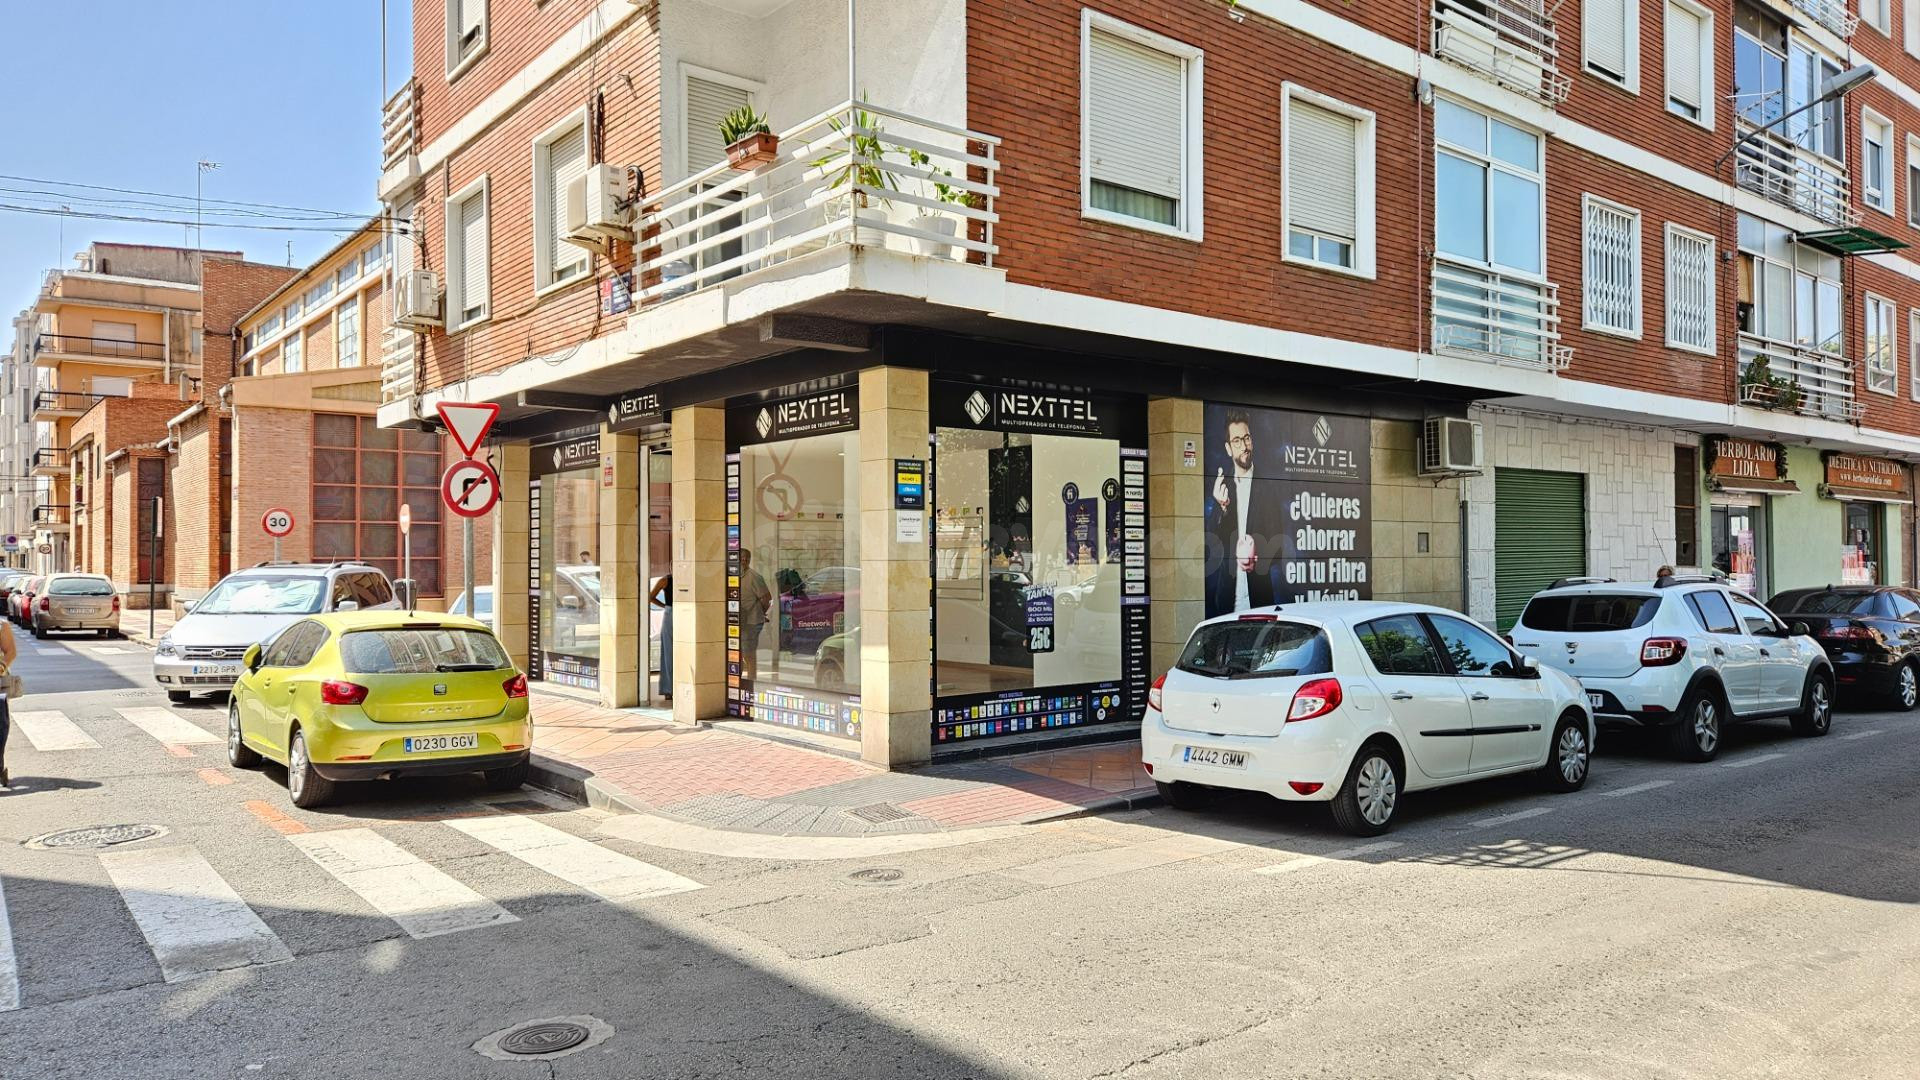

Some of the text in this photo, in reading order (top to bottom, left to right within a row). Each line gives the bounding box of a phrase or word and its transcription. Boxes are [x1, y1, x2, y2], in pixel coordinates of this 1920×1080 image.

[620, 393, 660, 415] NEXTTEL
[778, 393, 850, 424] NEXTTEL
[1001, 393, 1098, 421] NEXTTEL
[1001, 419, 1048, 428] MULTIOPERADOR
[564, 440, 600, 460] NEXTTEL
[1284, 445, 1357, 468] NEXTTEL
[1733, 459, 1761, 477] LIDIA
[1829, 455, 1861, 471] DIETETICA
[1290, 491, 1361, 520] ¿Quieres
[269, 517, 287, 528] 30
[1296, 525, 1357, 551] ahorrar
[1285, 558, 1367, 584] en tu Fibra
[797, 620, 831, 629] finetwork
[1030, 627, 1051, 650] 25€
[199, 666, 219, 674] 2212
[414, 735, 474, 750] 0230 GGV
[1191, 751, 1244, 767] 4442 GMM
